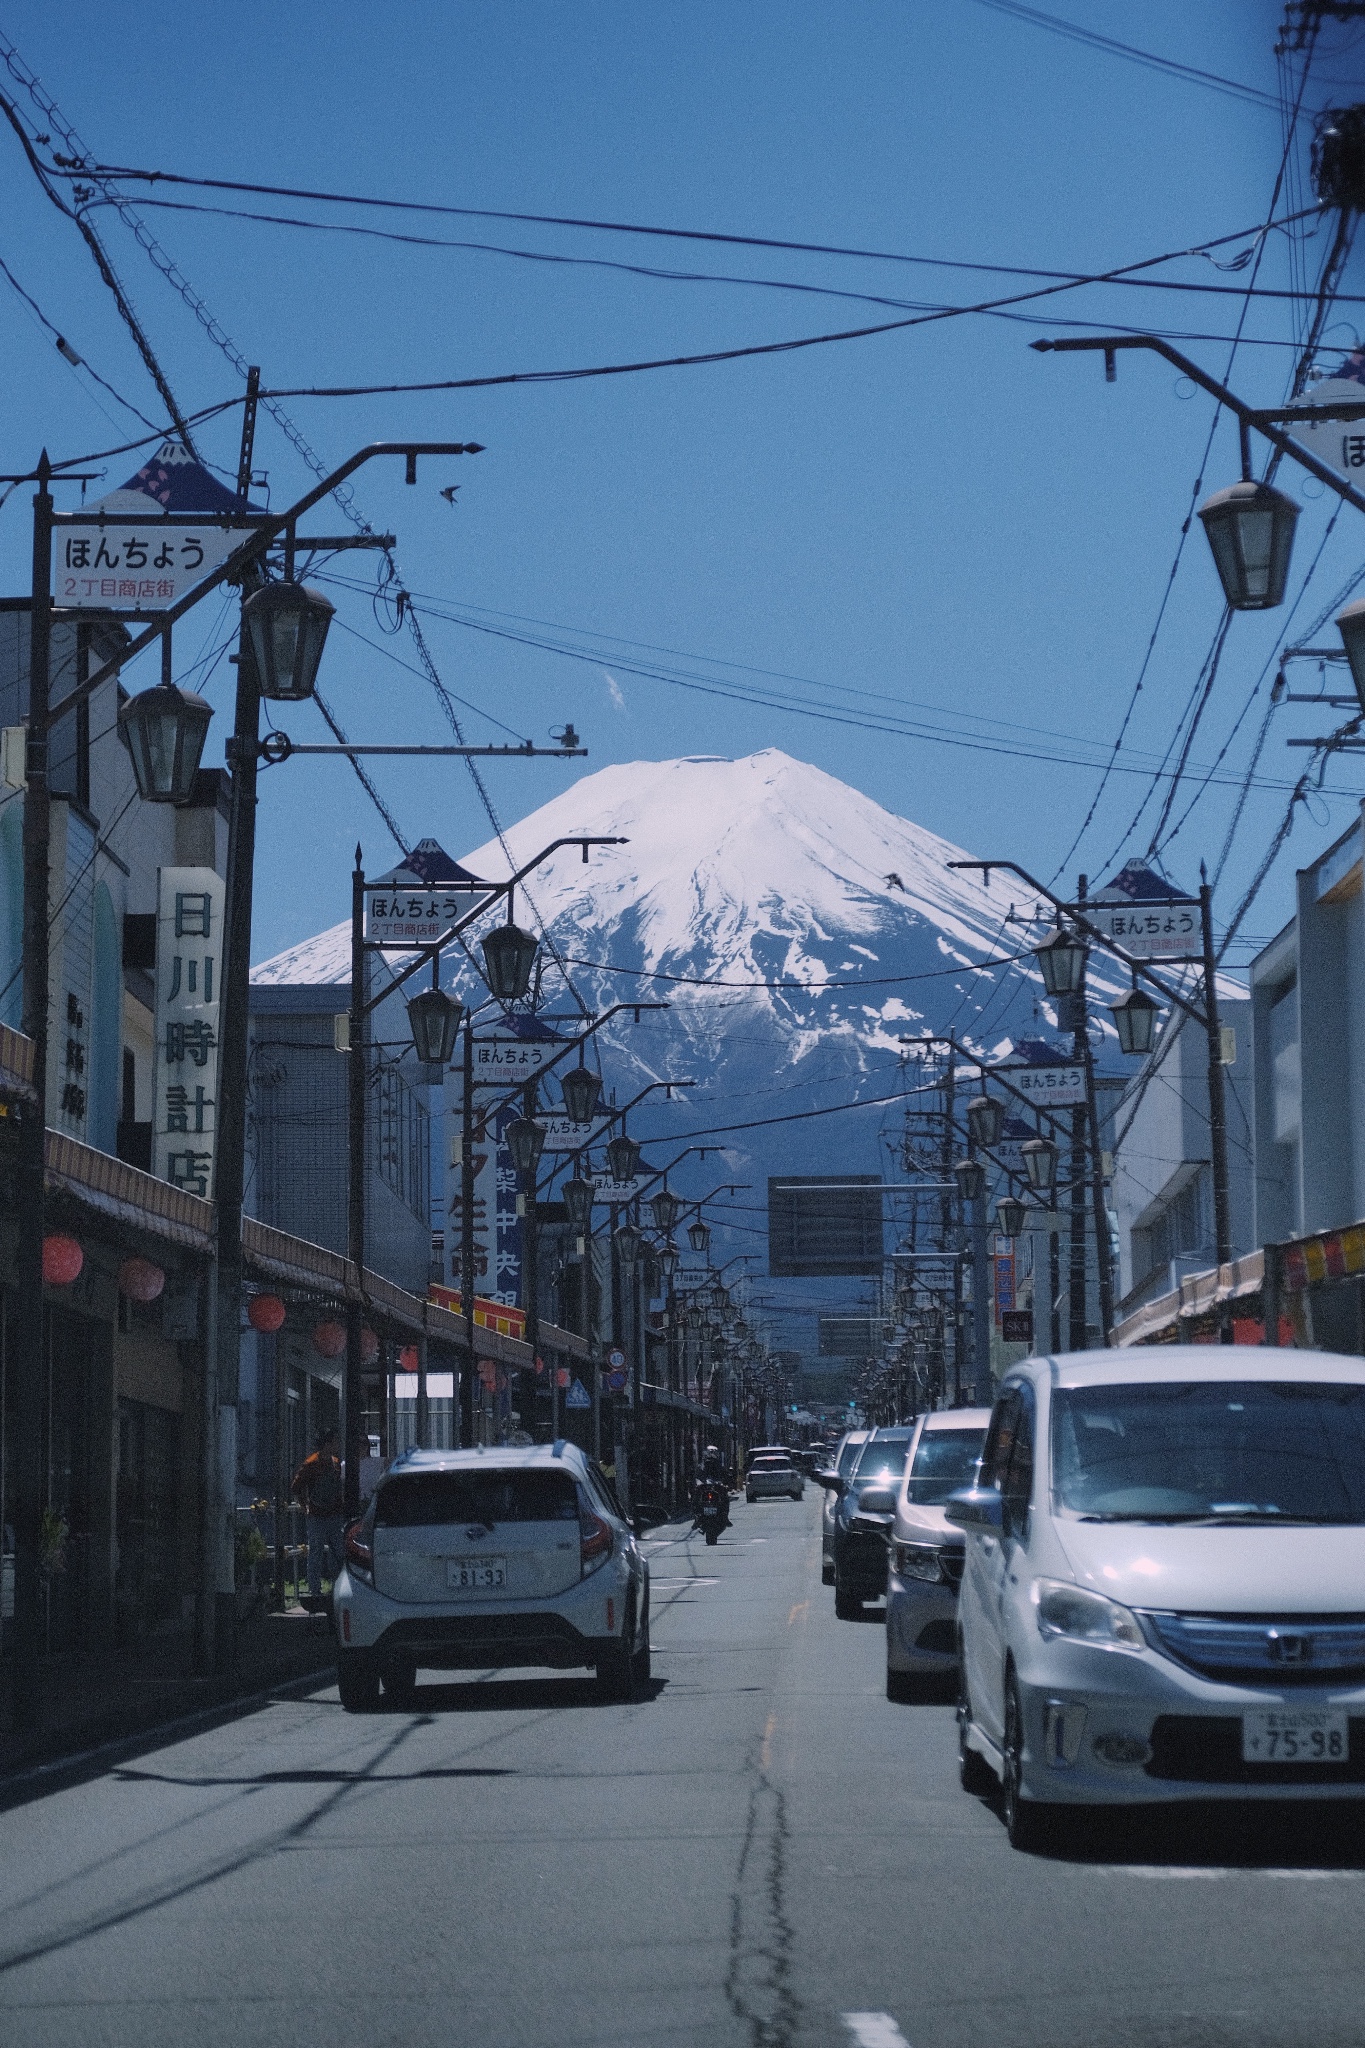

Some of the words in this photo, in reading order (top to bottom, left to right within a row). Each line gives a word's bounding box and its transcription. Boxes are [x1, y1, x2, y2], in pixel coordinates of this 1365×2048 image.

[65, 537, 204, 570] ほんちょう
[64, 577, 175, 598] 2丁目商店街
[371, 897, 458, 919] ほんちょう
[371, 923, 440, 935] 2丁目商店街
[1111, 913, 1193, 935] ほんちょう
[166, 891, 218, 1198] 日川時計店
[478, 1048, 543, 1065] ほんちょう
[1020, 1071, 1081, 1089] ほんちょう
[460, 1569, 504, 1586] 81-93
[1266, 1730, 1342, 1758] 75-98
